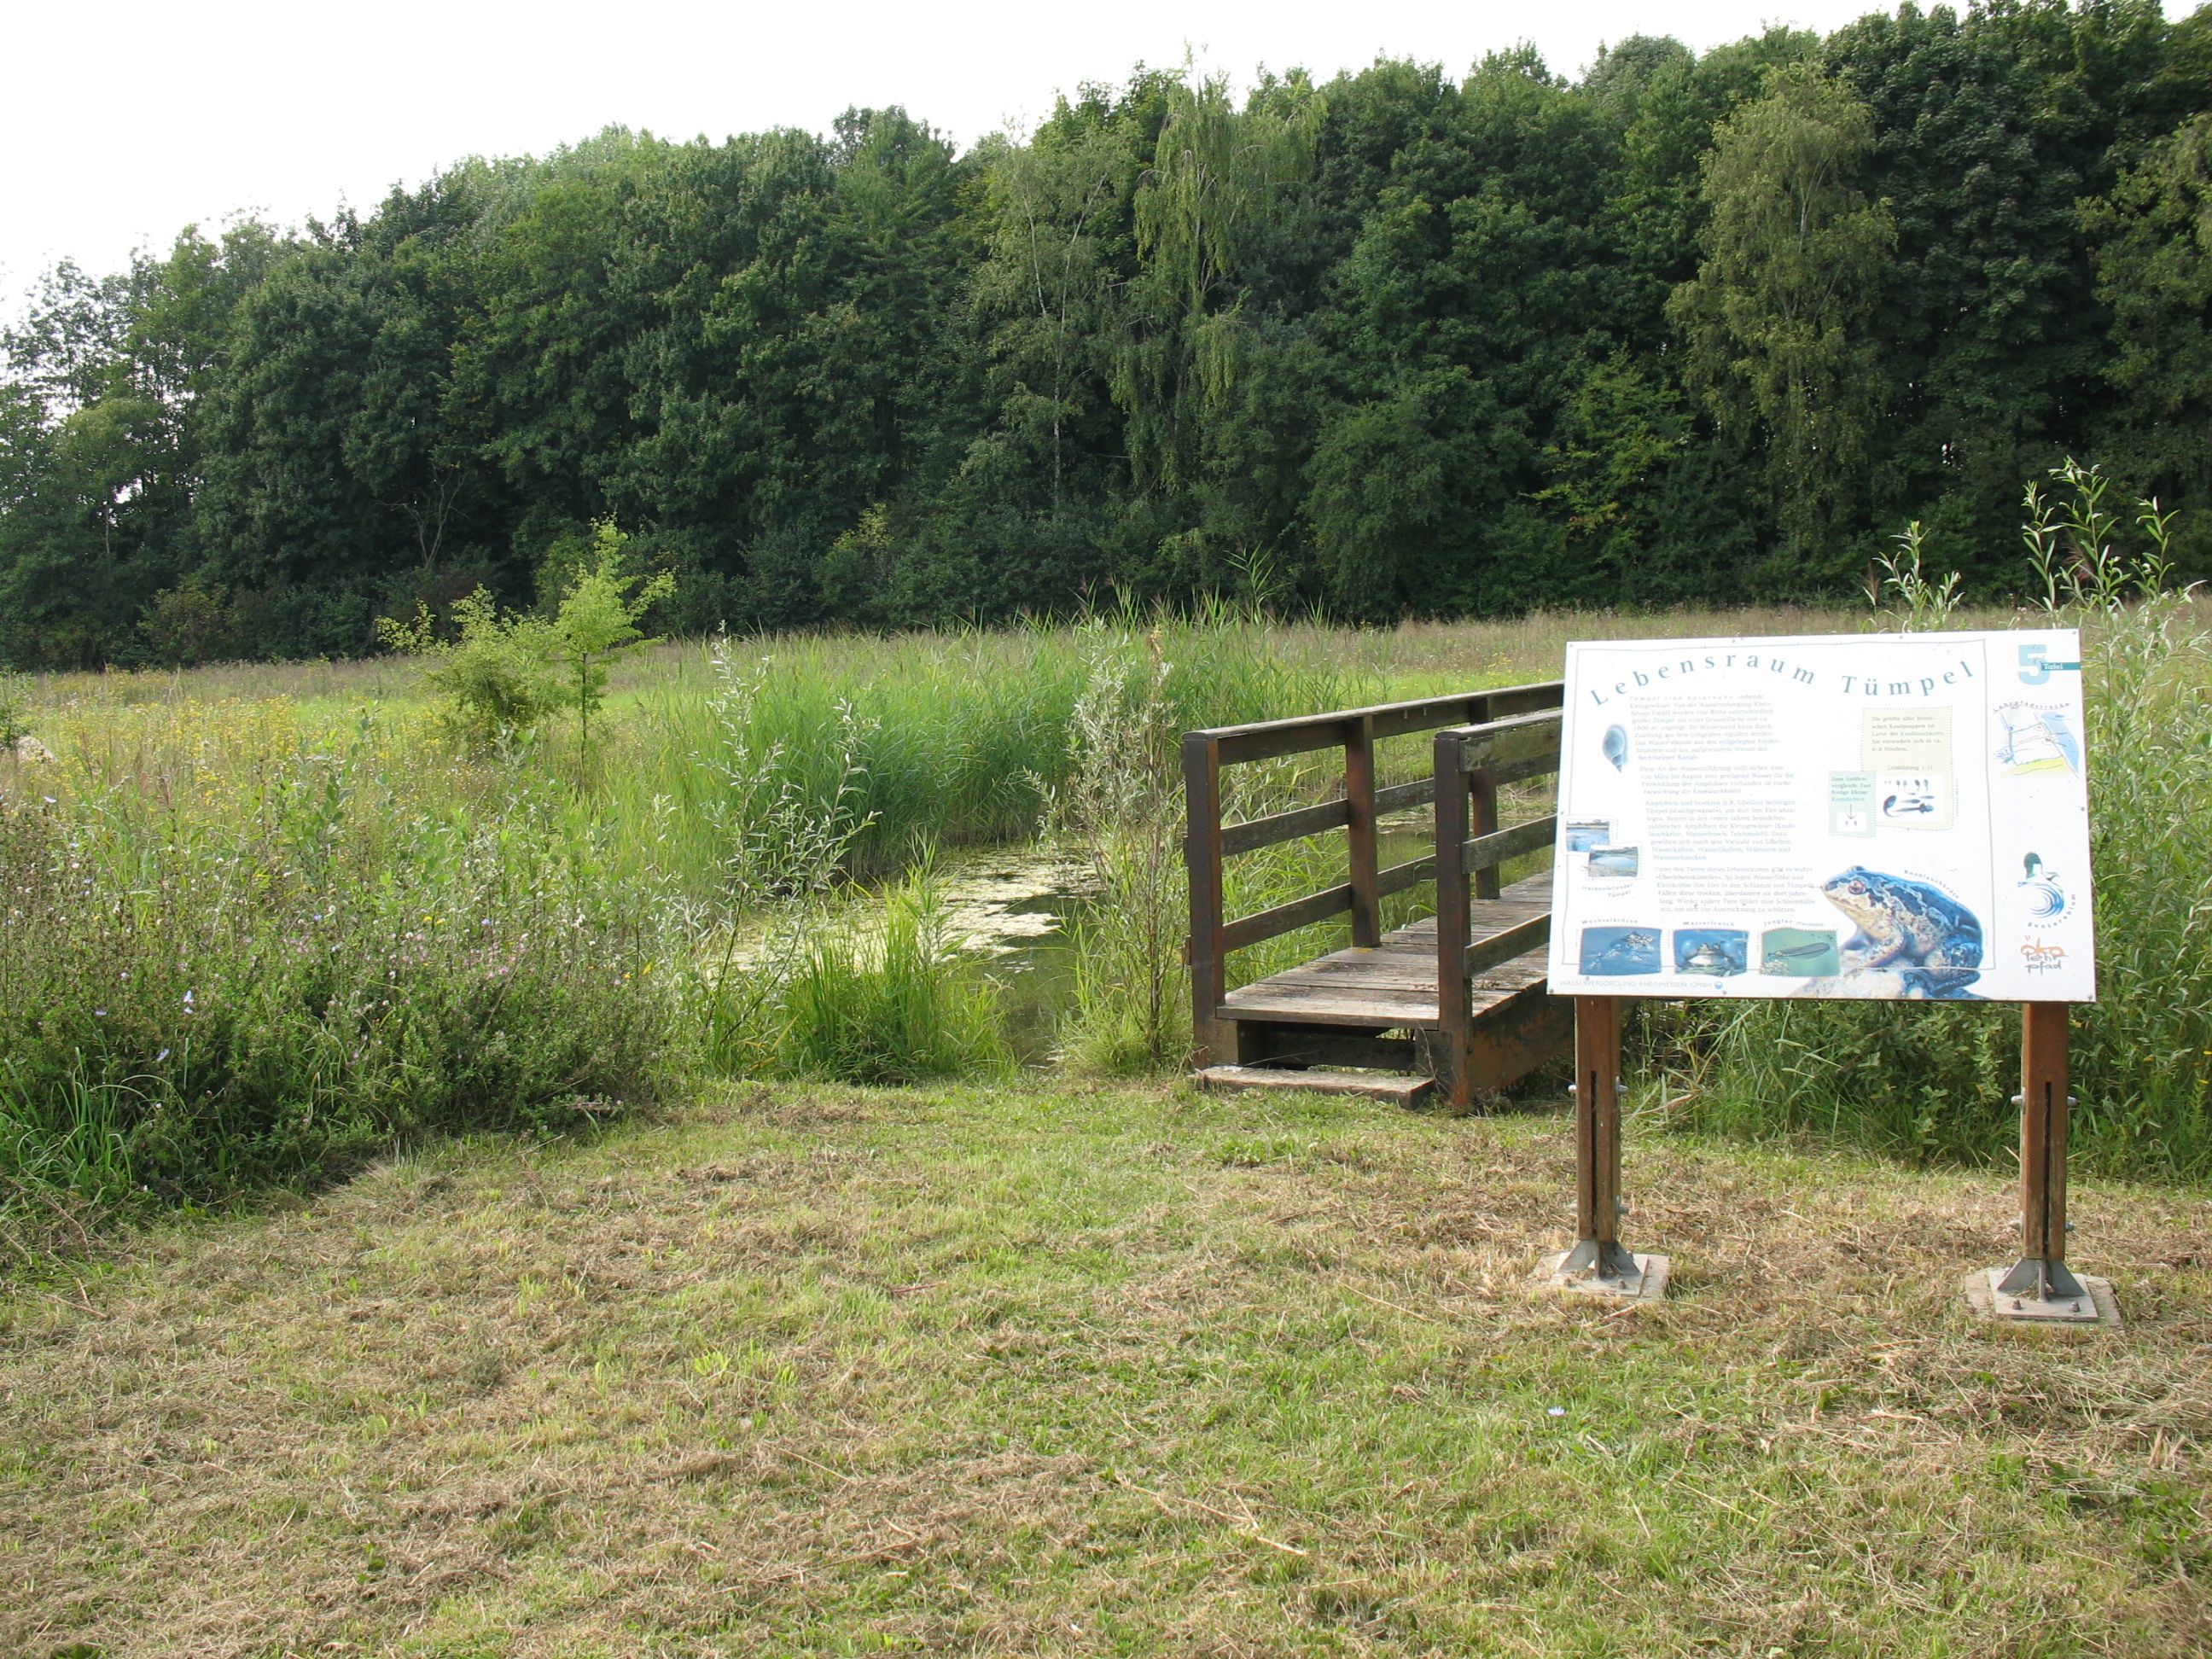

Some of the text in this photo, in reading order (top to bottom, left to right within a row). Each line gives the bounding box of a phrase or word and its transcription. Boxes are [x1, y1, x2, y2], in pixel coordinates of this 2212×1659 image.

[1590, 654, 1973, 705] Lebensraum Tümpel
[2017, 644, 2050, 685] 5
[1904, 870, 1959, 899] Knoblauchkröte
[2024, 959, 2062, 975] pfad
